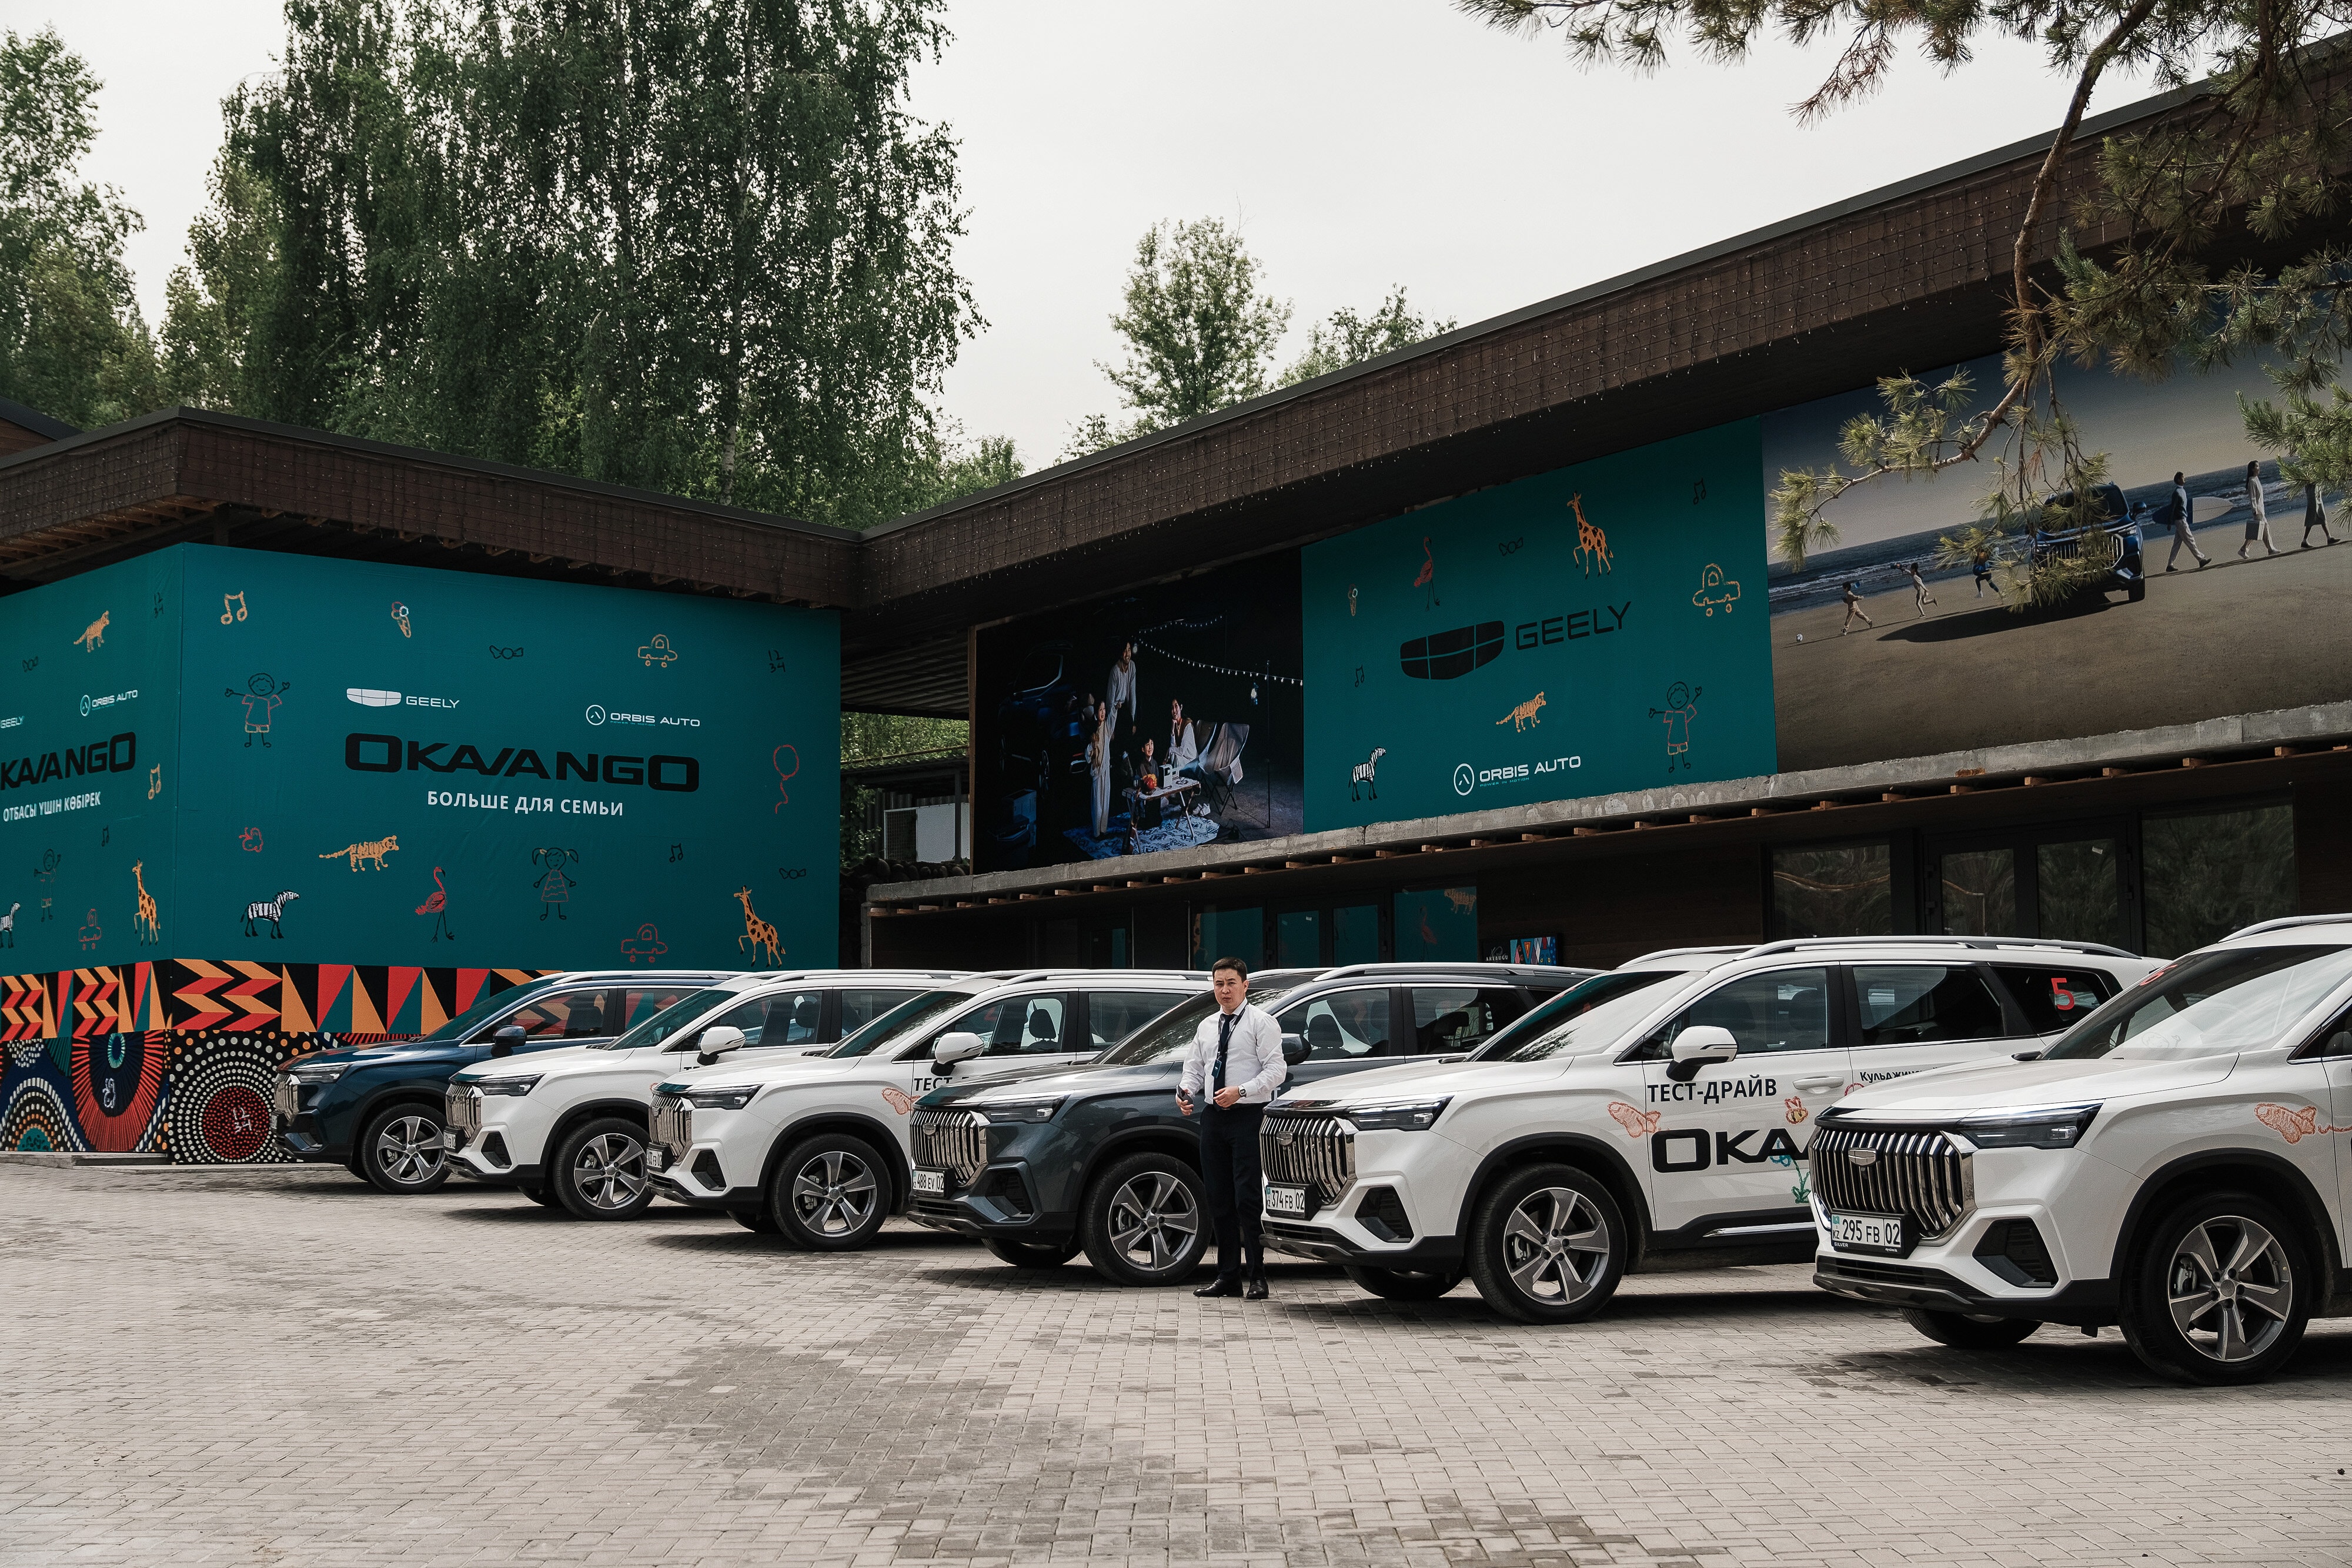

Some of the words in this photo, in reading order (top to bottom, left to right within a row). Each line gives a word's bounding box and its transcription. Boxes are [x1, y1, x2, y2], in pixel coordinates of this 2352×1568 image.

[1515, 601, 1632, 650] GEELY
[768, 649, 784, 661] 12
[769, 661, 786, 674] 34
[92, 695, 115, 707] ORBIS
[116, 689, 139, 702] AUTO
[405, 696, 460, 709] GEELY
[0, 716, 25, 728] GEELY
[610, 712, 656, 724] ORBIS
[660, 716, 701, 727] AUTO
[345, 733, 700, 793] OKAVANGO
[1479, 764, 1529, 783] ORBIS
[1534, 755, 1582, 774] AUTO
[3, 803, 38, 822] ОТБАСЫ
[39, 798, 62, 815] ҮШІН
[64, 791, 101, 811] КӨБІРЕК
[427, 791, 509, 810] БОЛЬШЕ
[514, 796, 554, 814] ДЛЯ
[560, 799, 623, 816] СЕМЬИ
[2051, 978, 2075, 1010] 5
[1647, 1074, 1777, 1105] ТЕСТ-ДРАЙВ
[917, 1174, 927, 1189] 488
[937, 1175, 944, 1191] 02
[1272, 1190, 1283, 1208] 374
[1285, 1195, 1293, 1209] FB
[1296, 1192, 1304, 1211] 02
[1832, 1230, 1840, 1239] KZ
[1842, 1218, 1863, 1242] 295
[1866, 1226, 1880, 1243] FB
[1885, 1222, 1900, 1245] 02
